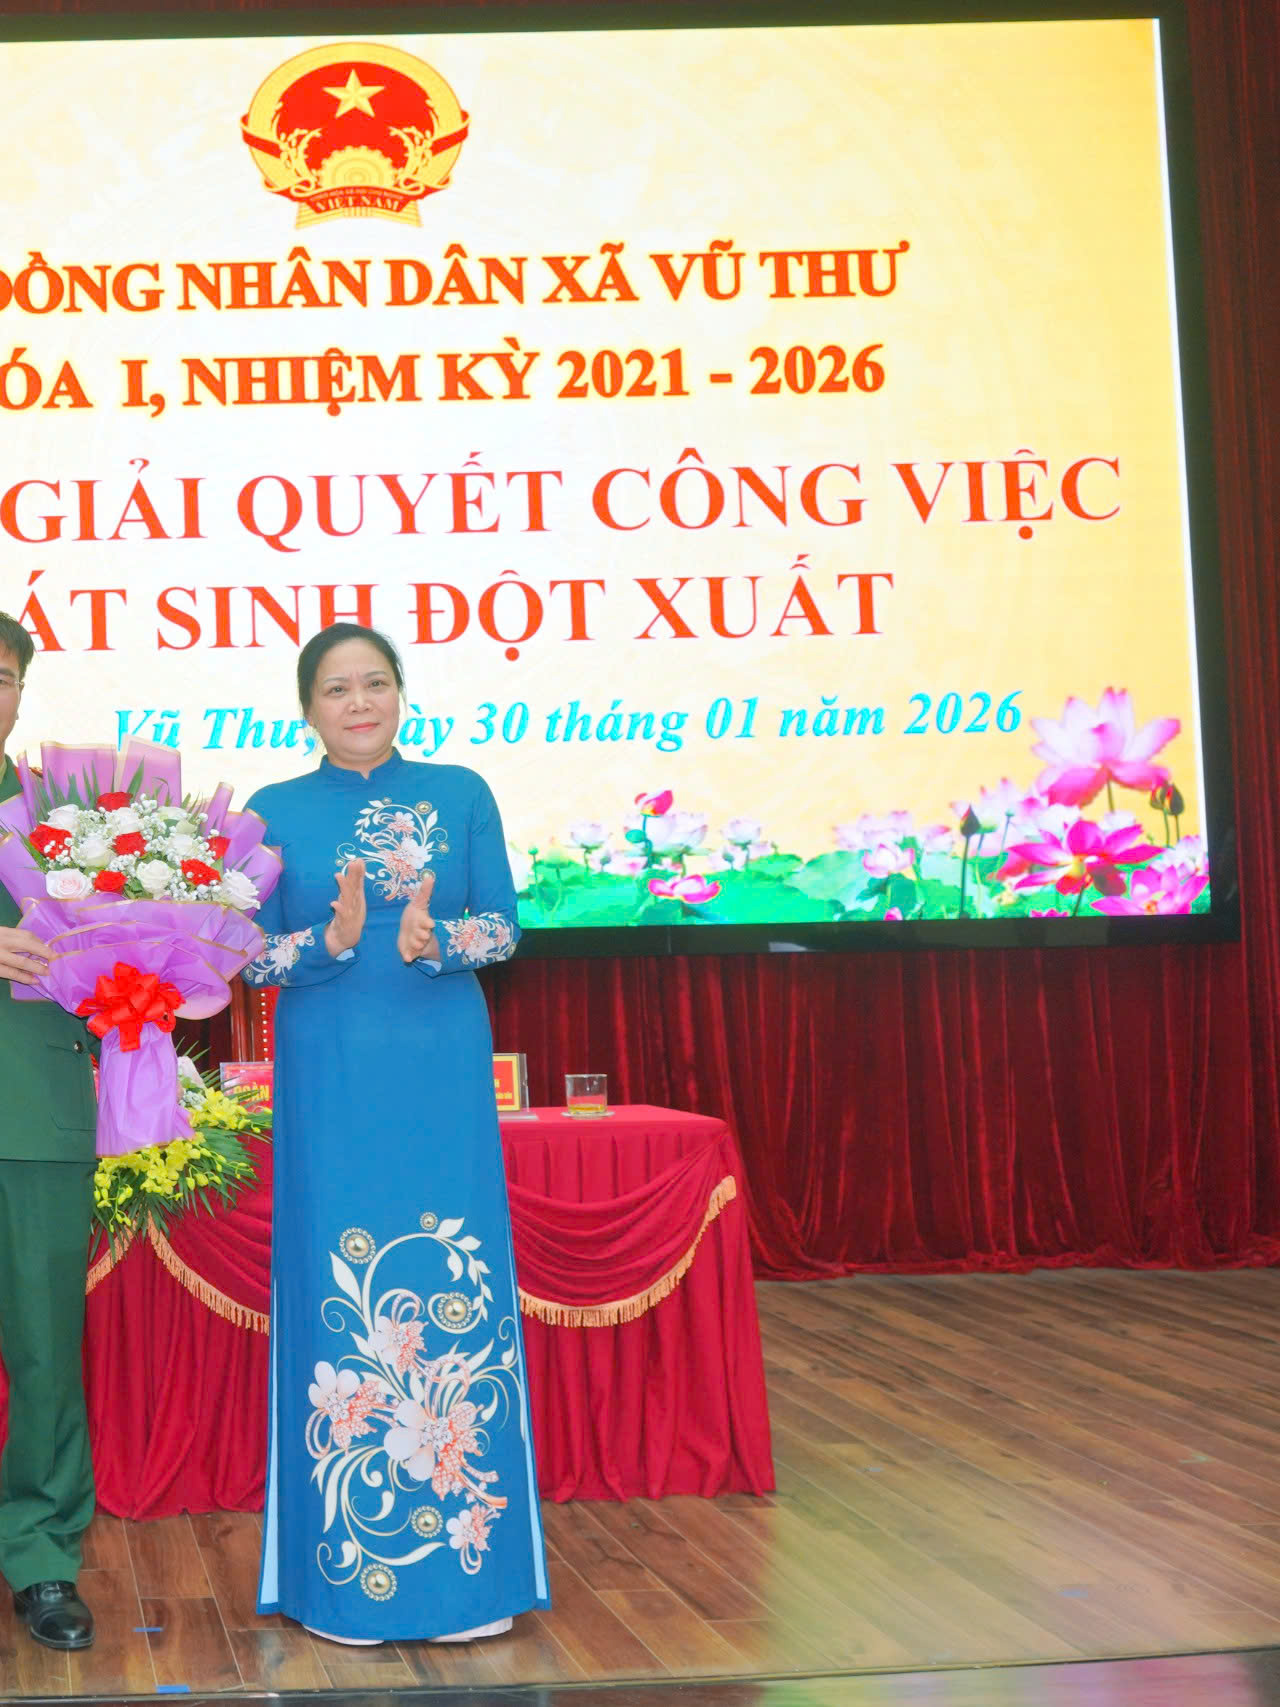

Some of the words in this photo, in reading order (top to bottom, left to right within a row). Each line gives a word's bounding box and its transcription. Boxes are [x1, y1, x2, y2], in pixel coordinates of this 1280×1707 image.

[360, 195, 400, 211] NAM
[177, 247, 370, 310] NHÂN
[384, 244, 527, 306] DÂN
[543, 243, 638, 302] XÃ
[650, 240, 744, 300] VŨ
[760, 240, 909, 298] THƯ
[122, 360, 165, 416] I,
[182, 348, 421, 416] NHIỆM
[438, 337, 539, 400] KỲ
[558, 349, 688, 398] 2021
[710, 374, 732, 383] -
[750, 344, 884, 394] 2026
[0, 458, 207, 543] GIẢI
[237, 451, 563, 552] QUYẾT
[592, 448, 869, 531] CÔNG
[890, 449, 1120, 539] VIỆC
[156, 584, 380, 649] SINH
[407, 569, 606, 661] ĐỘT
[633, 554, 894, 639] XUẤT
[115, 709, 180, 751] Vũ
[400, 704, 454, 757] ày
[470, 702, 529, 744] 30
[545, 699, 688, 752] tháng
[706, 697, 758, 739] 01
[779, 696, 884, 736] năm
[904, 691, 1021, 734] 2026
